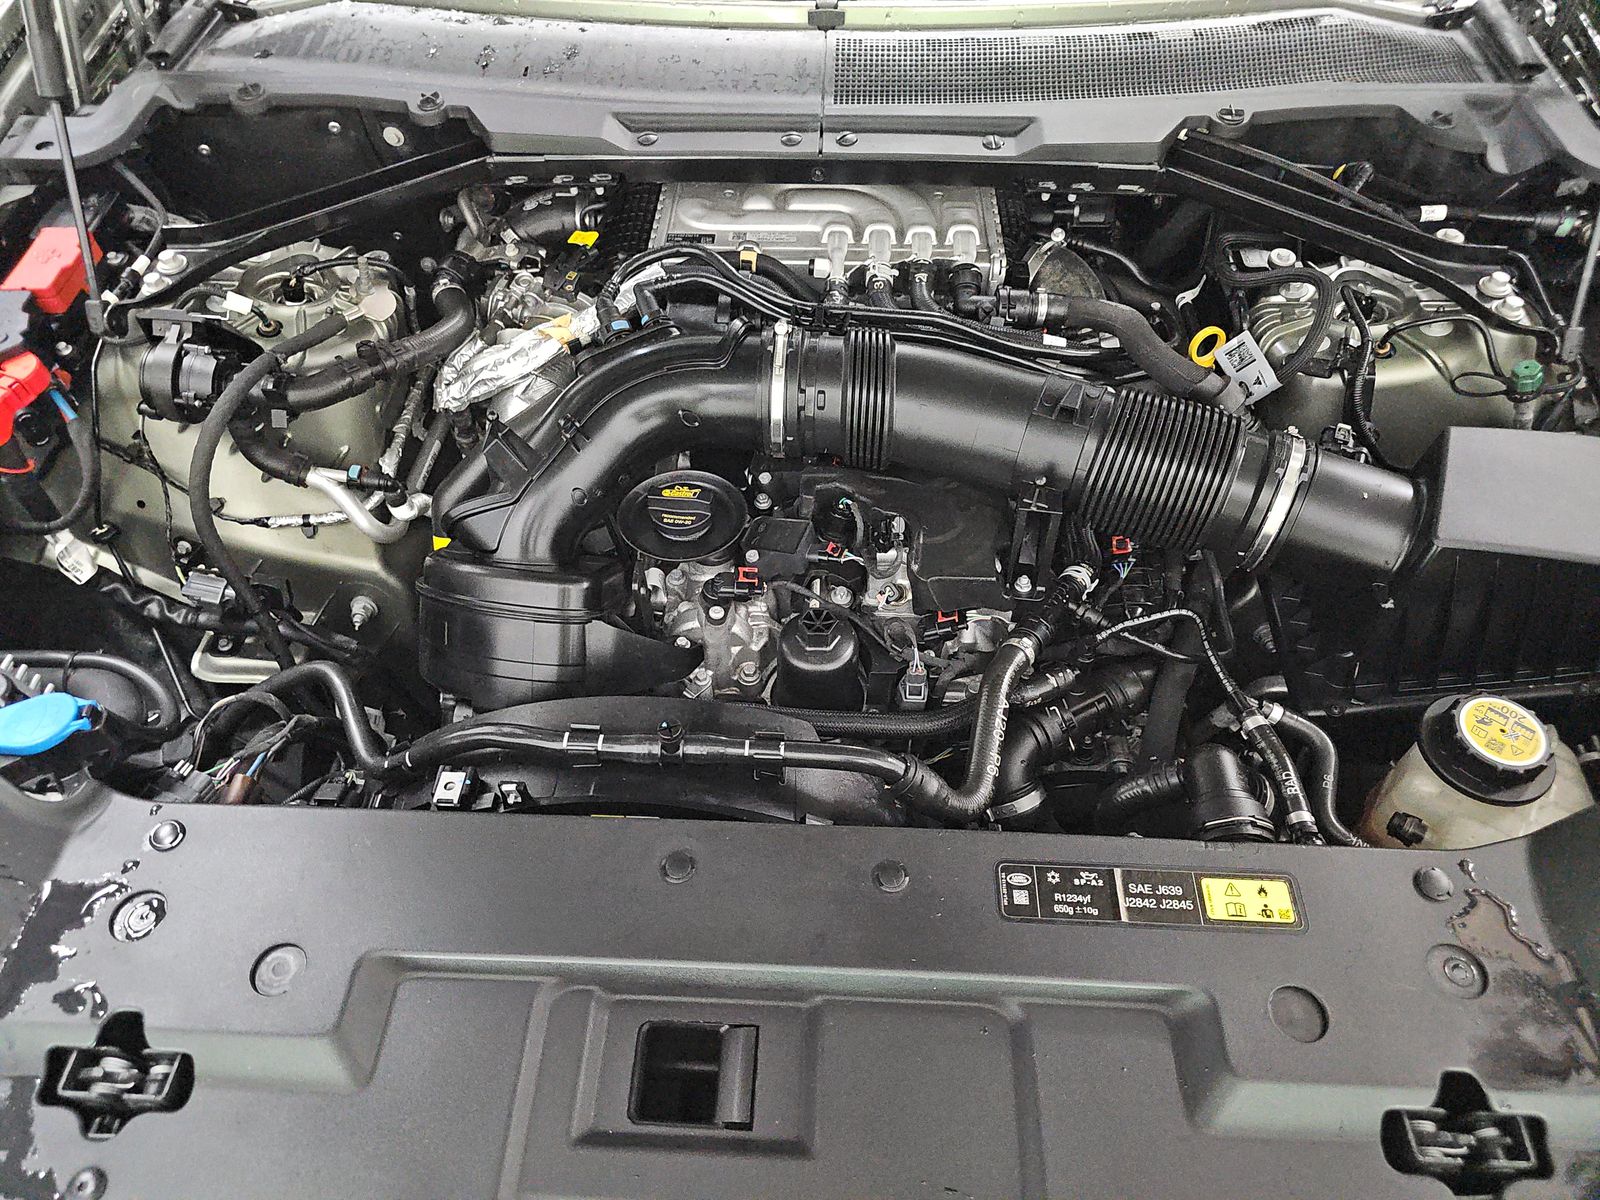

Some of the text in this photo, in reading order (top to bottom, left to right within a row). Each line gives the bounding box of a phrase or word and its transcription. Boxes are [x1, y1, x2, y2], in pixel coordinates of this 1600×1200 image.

[873, 281, 884, 290] 3
[1500, 705, 1527, 724] 200
[1073, 878, 1104, 887] SP-A2
[1128, 883, 1183, 896] SAE J639
[1054, 893, 1092, 905] R1234yf
[1123, 897, 1194, 911] J2842 J2845
[1053, 904, 1074, 915] 650g
